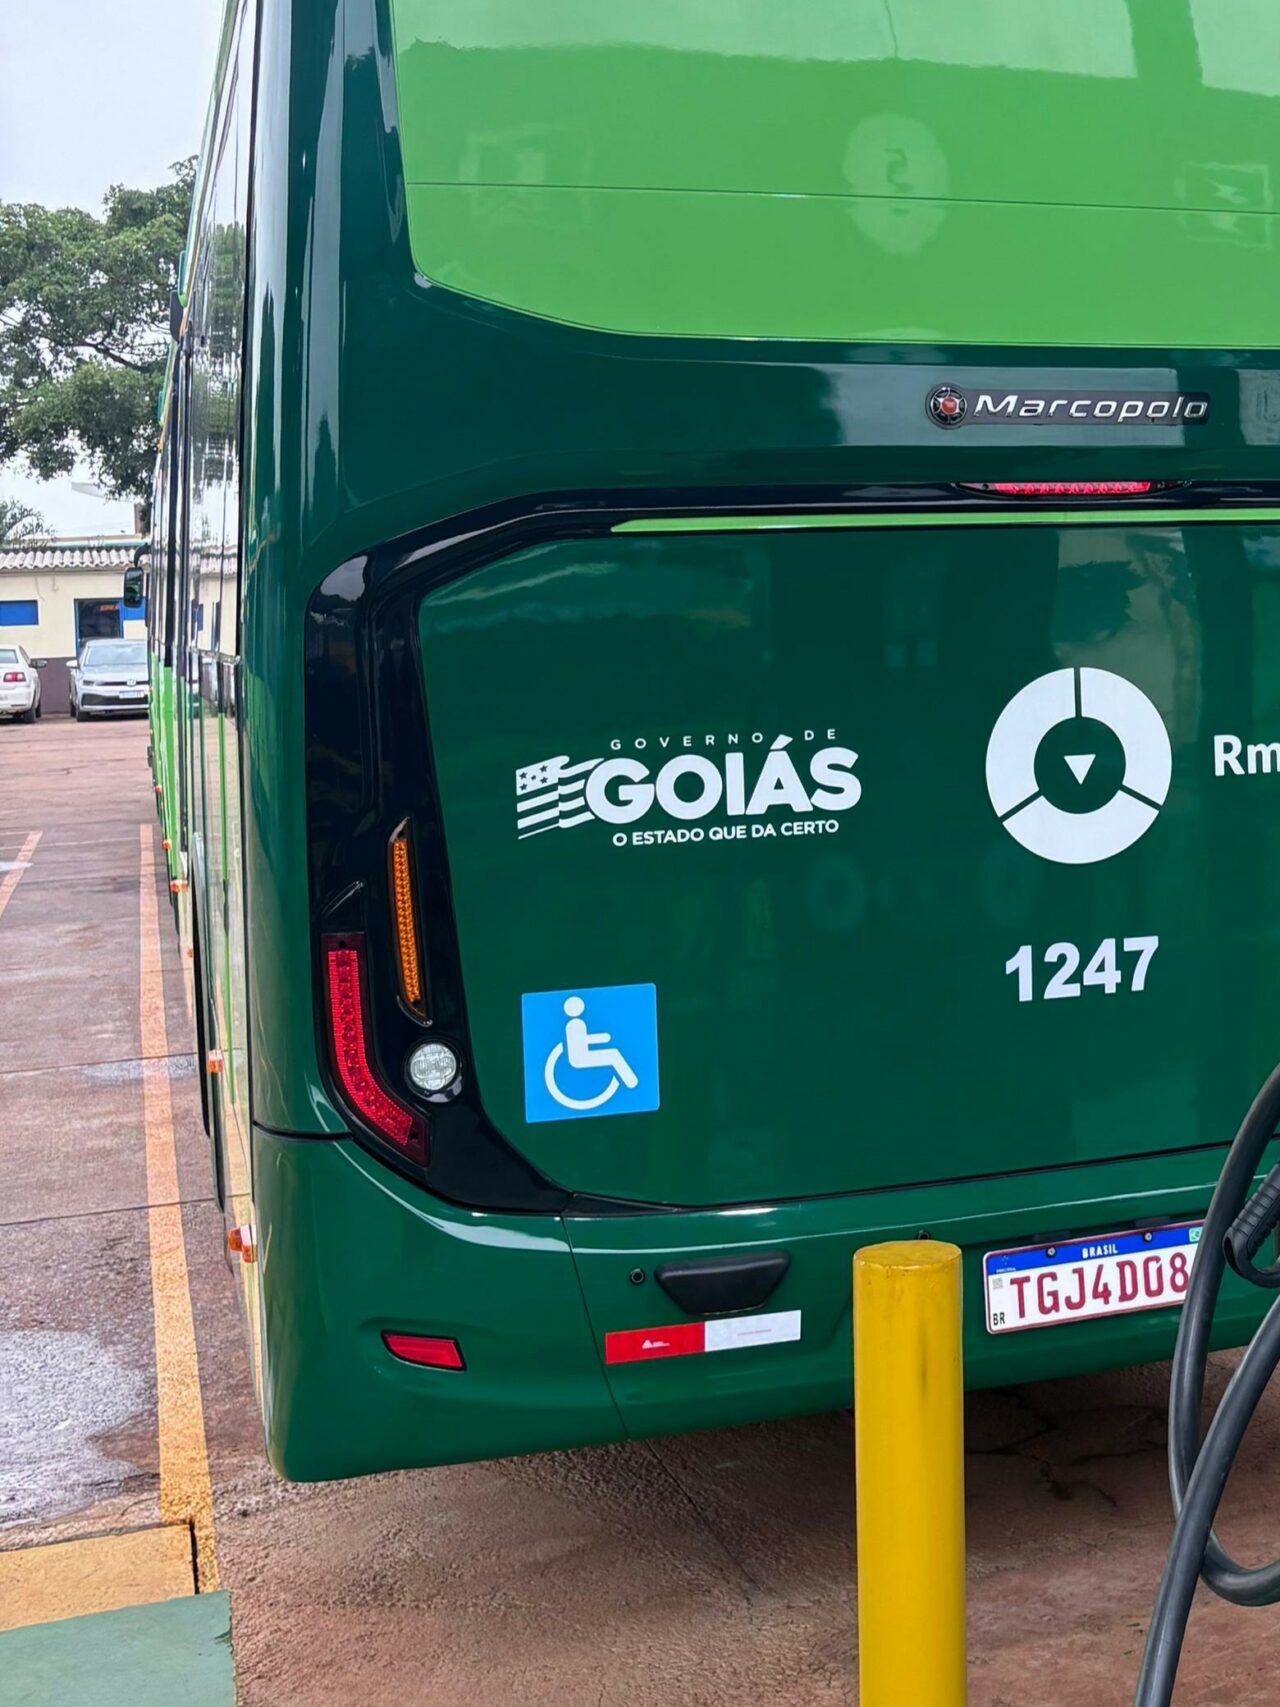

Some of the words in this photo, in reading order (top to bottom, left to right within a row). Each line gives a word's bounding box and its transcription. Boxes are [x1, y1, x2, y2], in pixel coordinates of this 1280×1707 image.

[973, 394, 1208, 423] Marcopolo
[610, 732, 763, 750] GOVERNO
[804, 729, 836, 741] DE
[585, 734, 862, 824] GOIÁS
[612, 832, 627, 847] O
[632, 828, 704, 845] ESTADO
[709, 825, 747, 840] QUE
[751, 823, 777, 838] DA
[780, 820, 839, 836] CERTO
[1005, 935, 1160, 1002] 1247
[1081, 1244, 1119, 1259] BRASIL
[1010, 1252, 1189, 1319] TGJ4D08
[992, 1312, 1006, 1326] BR
